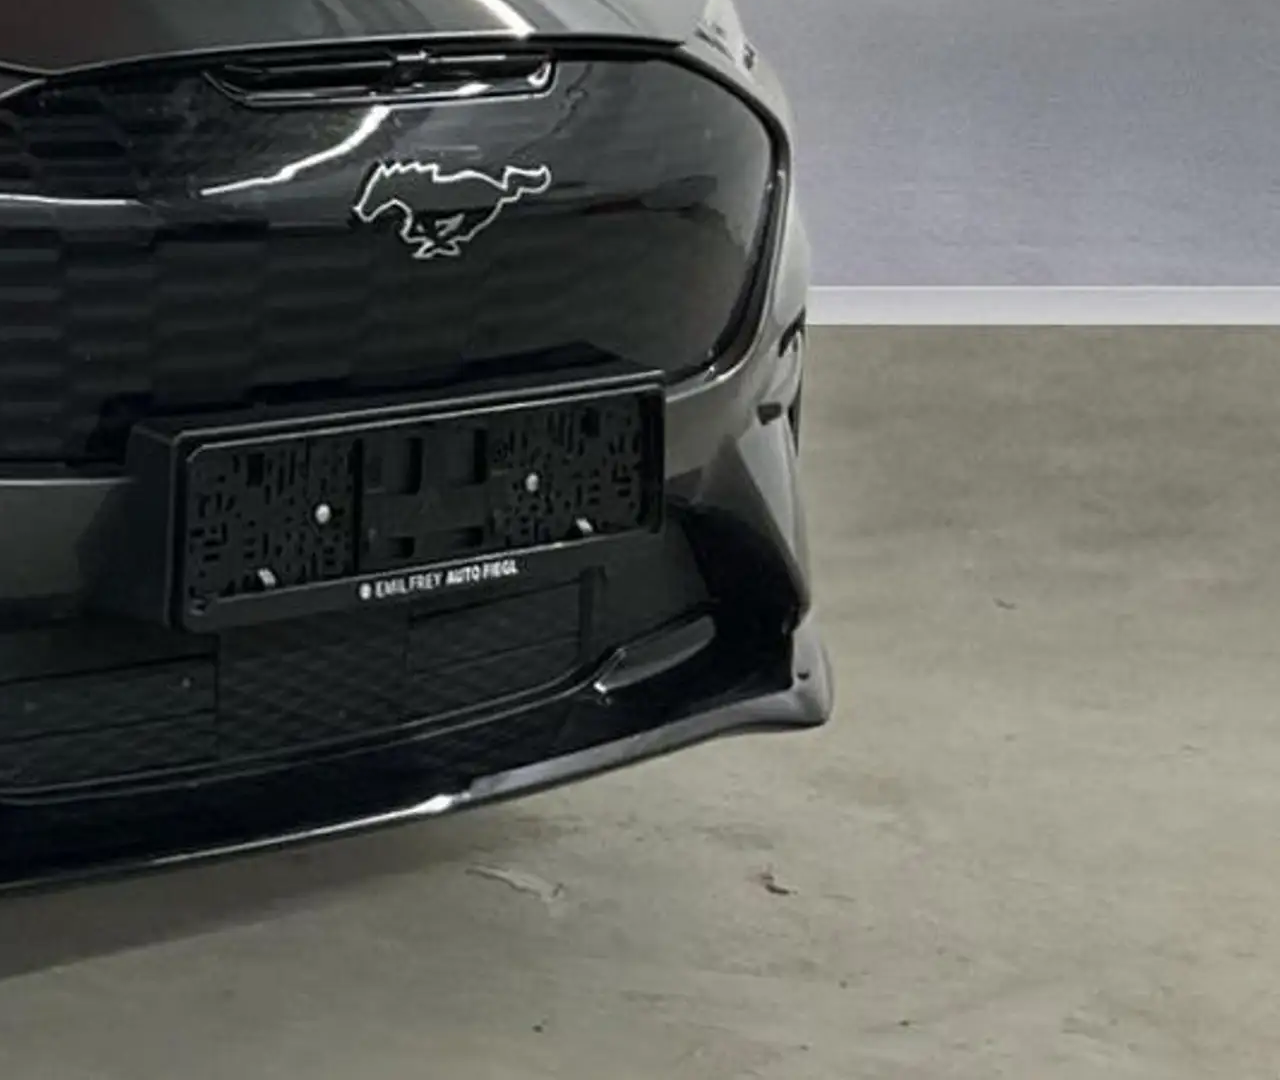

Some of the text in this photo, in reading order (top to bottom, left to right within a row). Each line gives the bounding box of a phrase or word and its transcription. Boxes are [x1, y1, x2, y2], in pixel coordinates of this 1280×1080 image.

[375, 579, 407, 598] EMIL
[409, 572, 442, 589] FREY
[445, 565, 480, 585] AUTO
